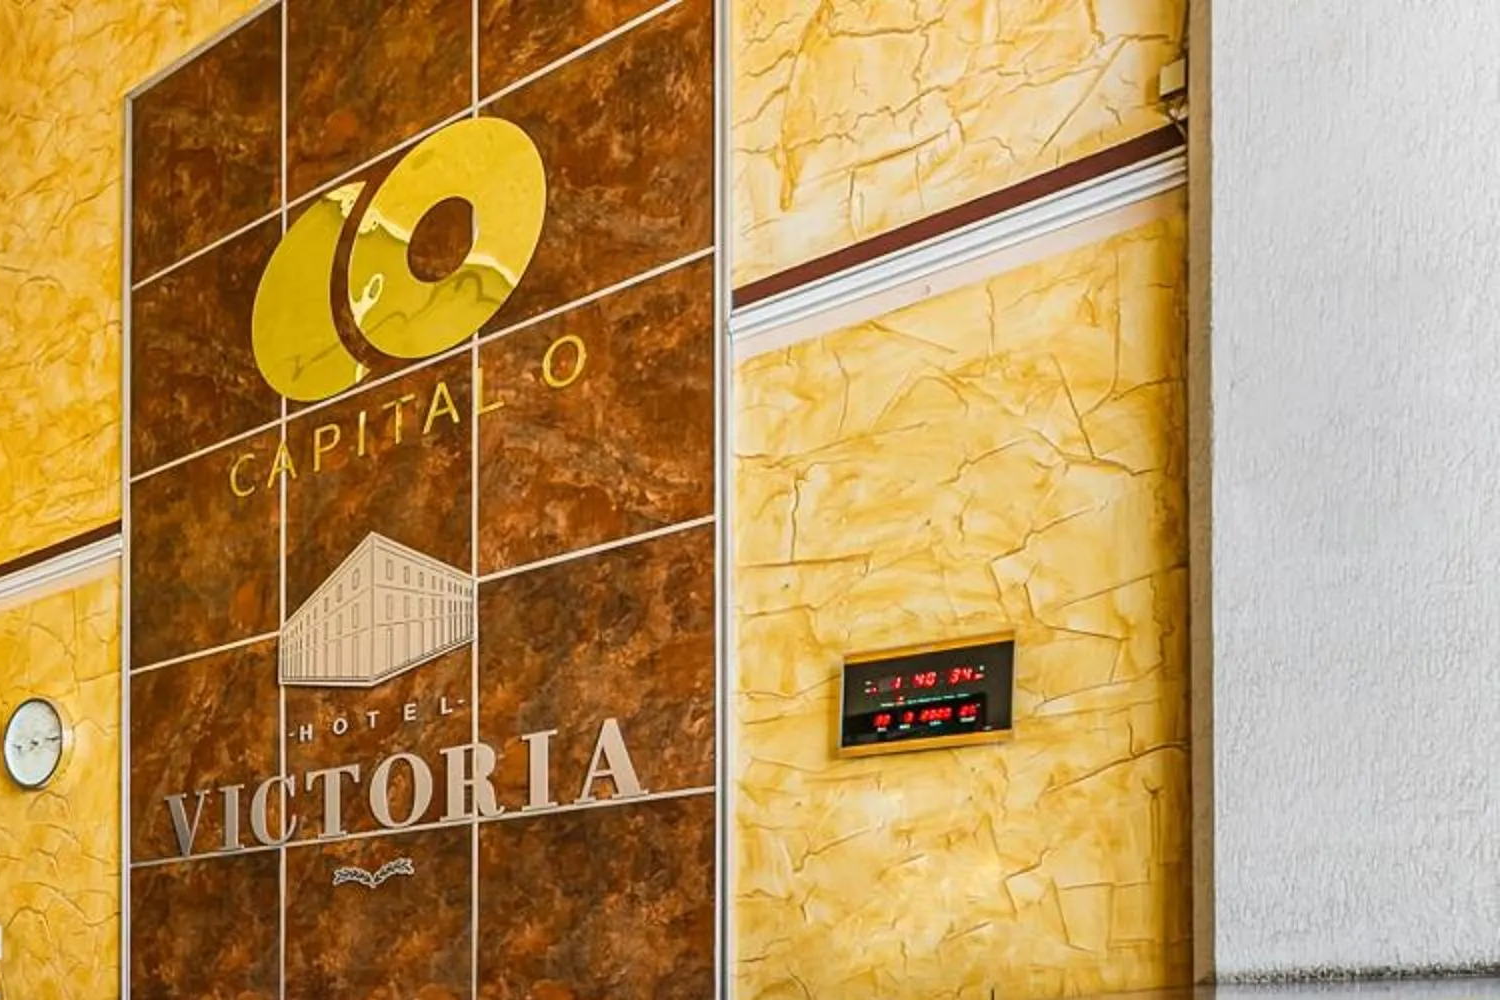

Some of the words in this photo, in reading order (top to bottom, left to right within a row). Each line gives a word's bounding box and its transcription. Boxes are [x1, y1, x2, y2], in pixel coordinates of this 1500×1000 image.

[229, 366, 504, 497] CAPITAL
[542, 334, 587, 389] O
[163, 717, 650, 858] VICTORIA
